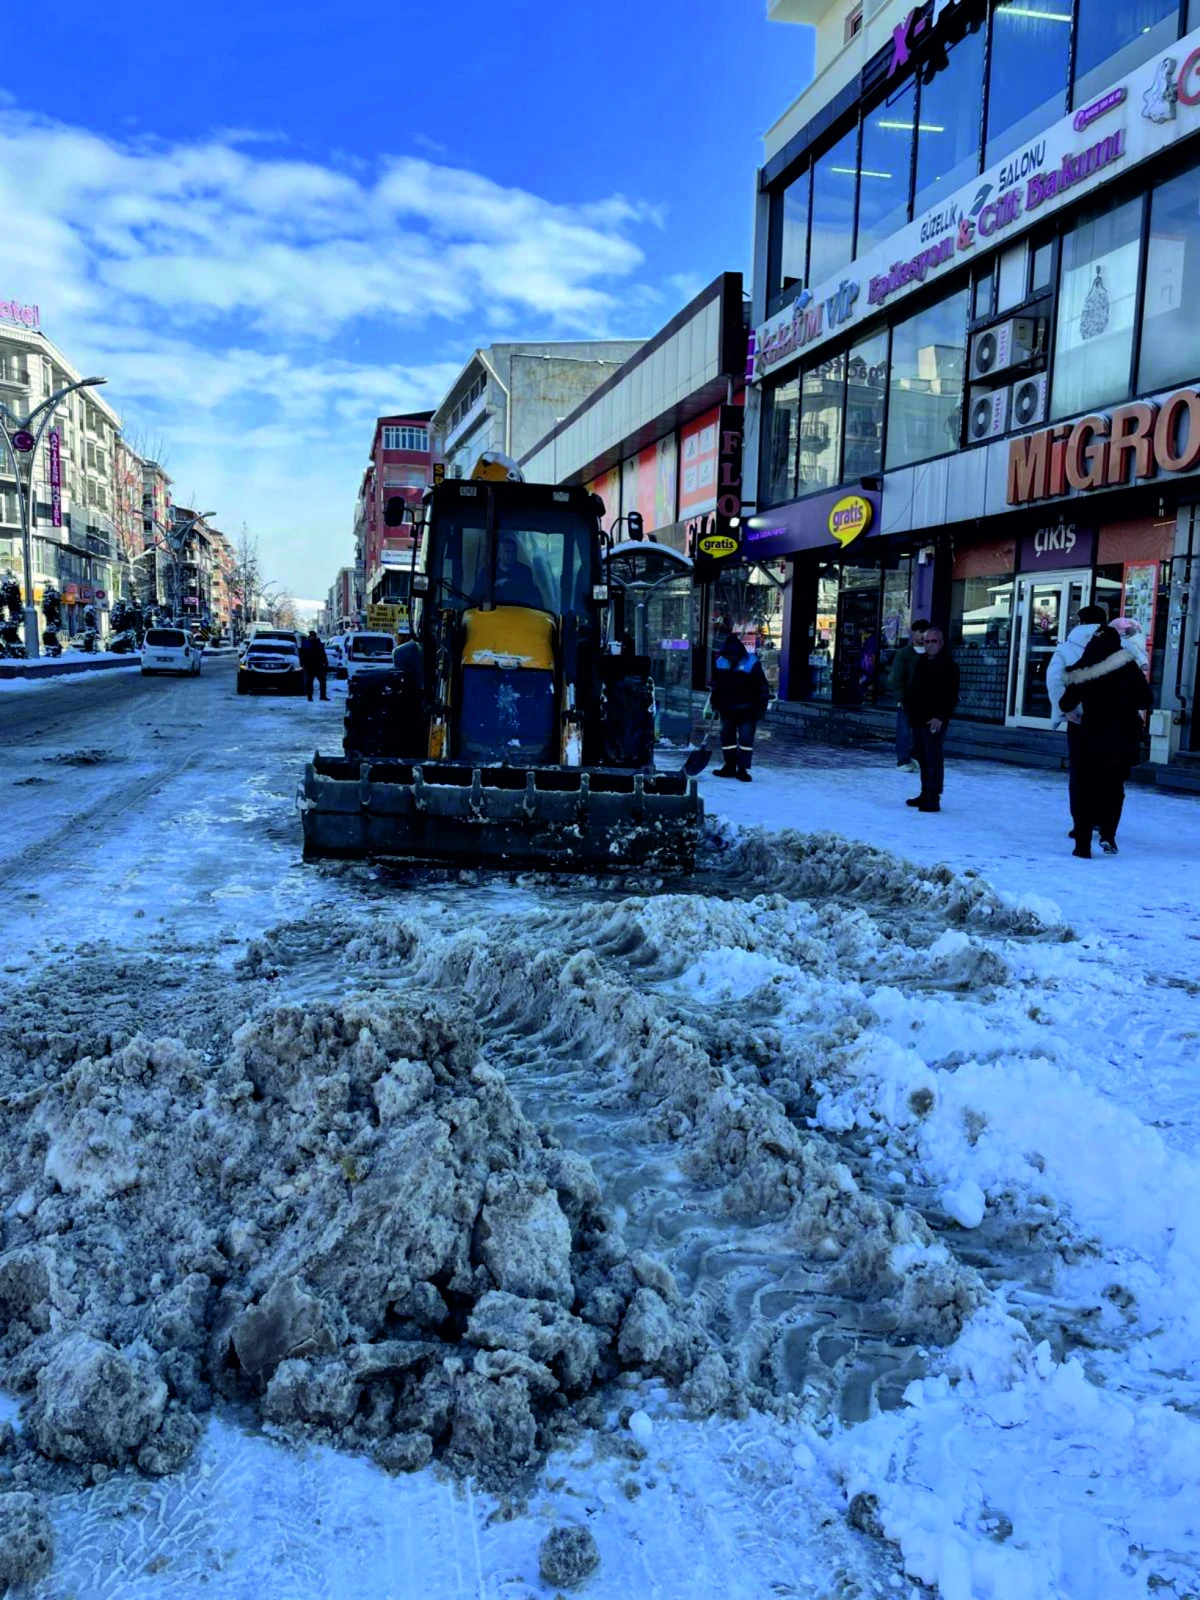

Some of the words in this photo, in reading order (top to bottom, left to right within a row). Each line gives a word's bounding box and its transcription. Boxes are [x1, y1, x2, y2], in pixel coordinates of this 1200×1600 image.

[999, 140, 1045, 192] SALONU
[868, 237, 955, 305] Epilasyon
[978, 187, 1024, 236] Cilt
[1025, 129, 1125, 212] Bakımı
[718, 430, 741, 517] FLO
[833, 500, 863, 532] gratis
[704, 539, 734, 550] gratis
